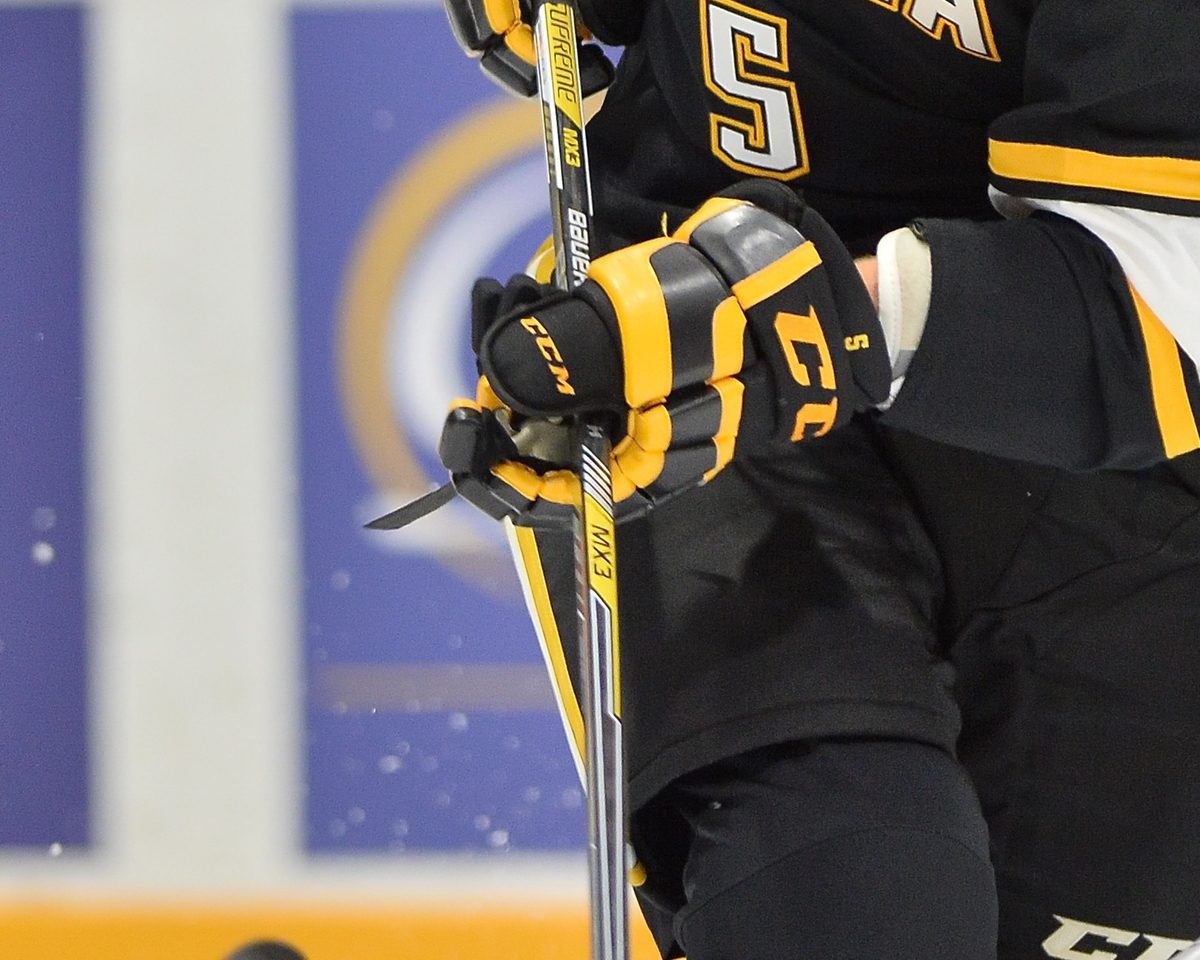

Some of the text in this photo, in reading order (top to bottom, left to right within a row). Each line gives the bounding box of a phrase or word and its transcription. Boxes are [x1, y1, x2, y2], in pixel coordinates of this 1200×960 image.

[563, 127, 581, 168] MX3
[519, 316, 576, 396] CCM
[844, 334, 870, 352] 5
[591, 525, 612, 580] MX3
